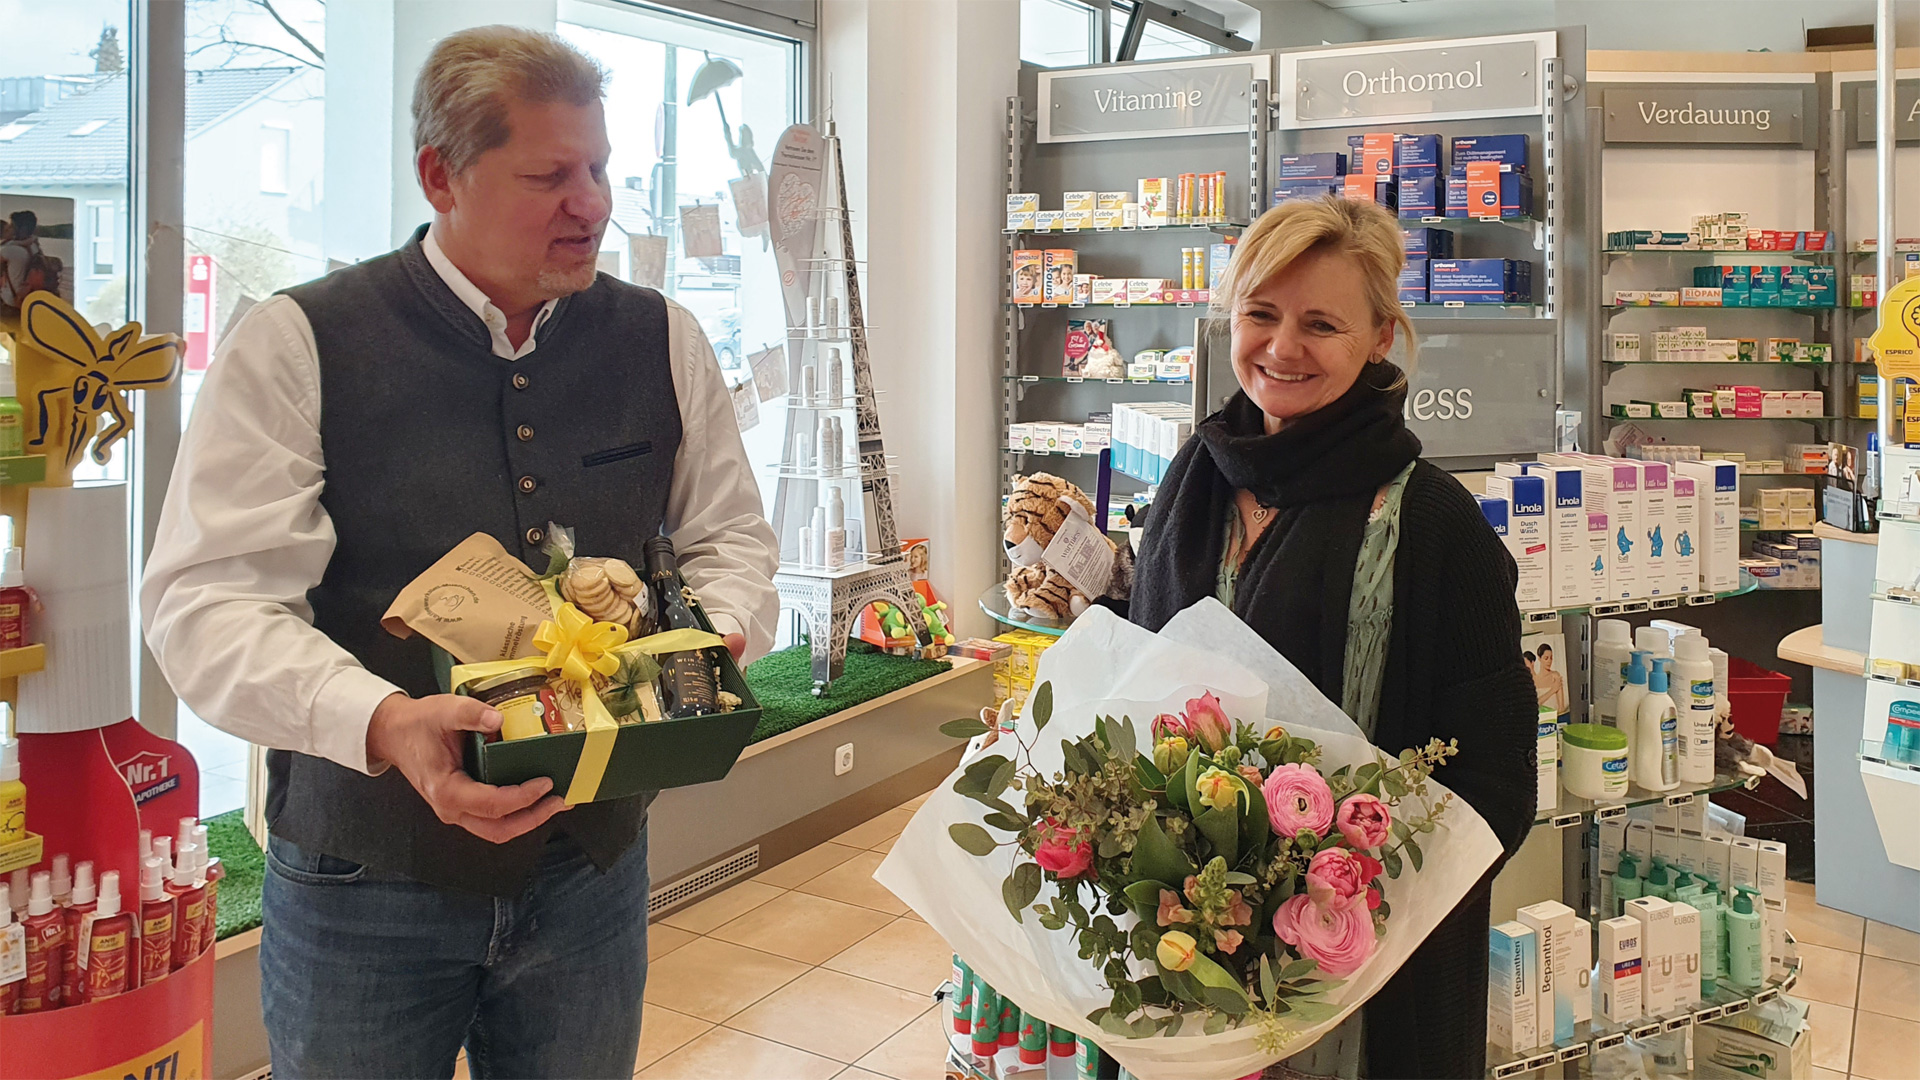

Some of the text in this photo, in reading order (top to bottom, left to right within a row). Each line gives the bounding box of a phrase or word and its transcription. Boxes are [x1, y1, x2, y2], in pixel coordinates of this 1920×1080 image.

[1342, 60, 1484, 97] Orthomol
[1093, 86, 1203, 114] Vitamine
[1638, 101, 1771, 130] Verdauung
[1045, 252, 1053, 300] sanostol
[1685, 289, 1721, 298] RIOPAN
[1516, 504, 1542, 513] Linola
[500, 621, 516, 658] klassische
[136, 778, 176, 802] APOTHEKE
[1650, 910, 1670, 922] EUBOS
[1674, 915, 1696, 926] EUBOS
[1619, 938, 1637, 950] EUBOS
[1542, 925, 1552, 993] Bepanthol
[1621, 961, 1635, 969] UREA
